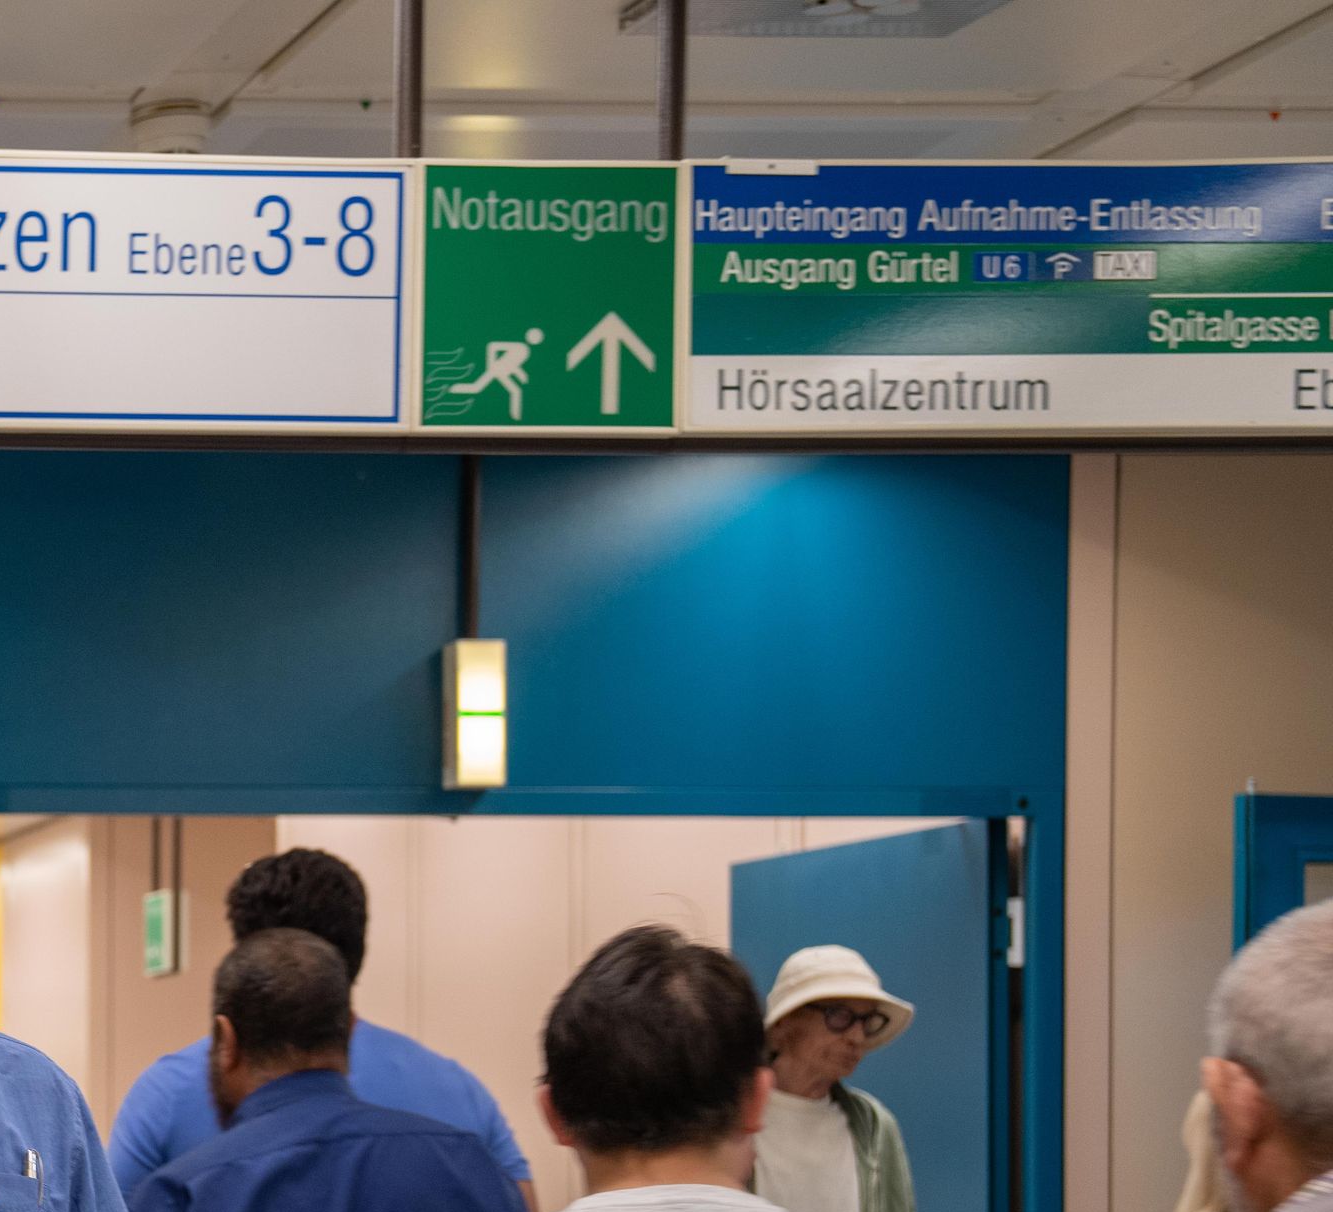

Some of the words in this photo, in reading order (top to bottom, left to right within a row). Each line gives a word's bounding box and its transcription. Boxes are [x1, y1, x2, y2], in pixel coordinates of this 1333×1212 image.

[128, 232, 247, 277] Ebene
[253, 194, 376, 277] 3-8
[432, 187, 669, 243] Notausgang
[694, 199, 907, 239] Haupteingang
[917, 198, 1262, 238] Aufnahme-Entlassung
[720, 250, 857, 291] Ausgang
[867, 249, 960, 284] Gürtel
[982, 254, 1022, 279] U6
[1095, 253, 1156, 278] TAXI
[1148, 308, 1320, 349] Spitalgasse
[716, 369, 1052, 412] Hörsaalzentrum
